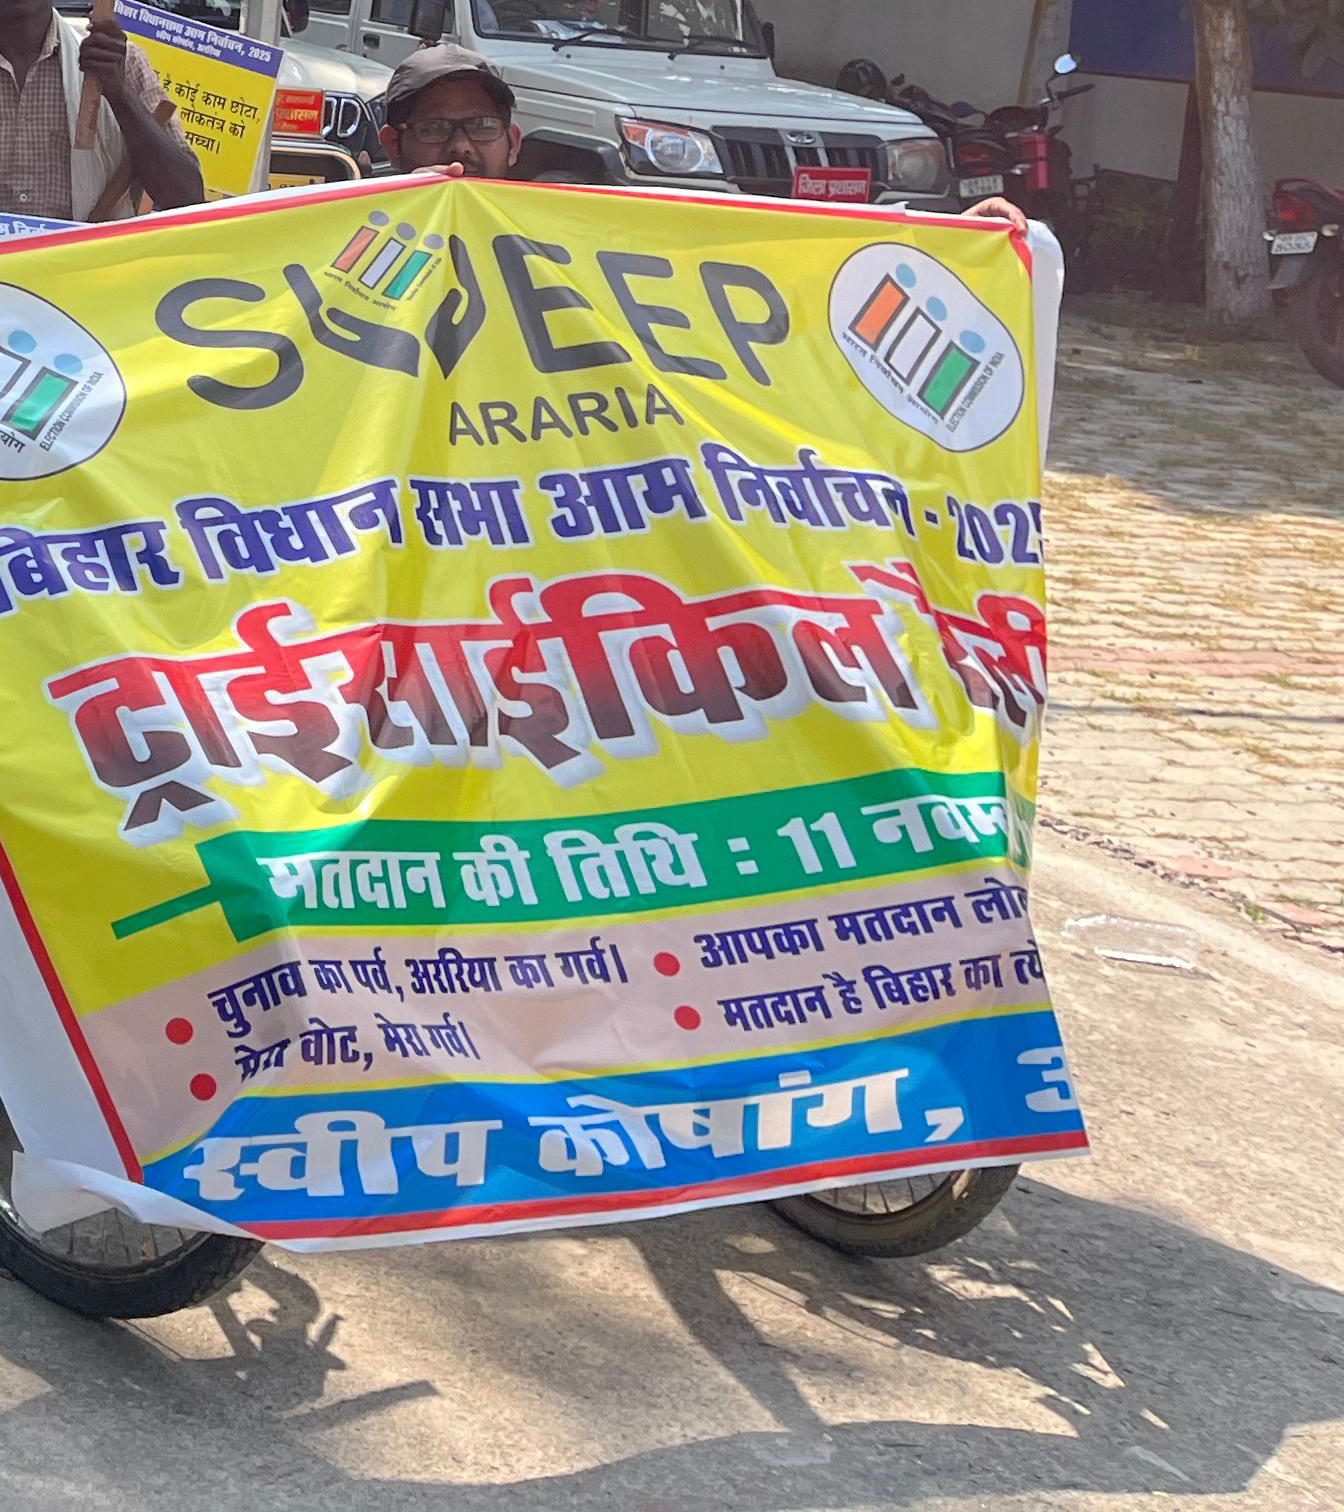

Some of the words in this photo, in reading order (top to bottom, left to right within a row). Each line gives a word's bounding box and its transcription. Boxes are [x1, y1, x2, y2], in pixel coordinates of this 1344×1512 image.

[228, 119, 247, 139] को
[449, 382, 685, 447] ARARIA
[177, 479, 403, 580] विधान
[411, 478, 529, 547] सभा
[539, 457, 708, 535] आम
[701, 442, 915, 537] निर्वाचन
[256, 852, 441, 909] मतदान
[452, 833, 539, 907] की
[543, 821, 708, 904] तिथि
[776, 810, 857, 874] 11
[693, 918, 825, 970] आपका
[828, 895, 963, 948] मतदान
[207, 960, 307, 1039] चुनाव
[308, 959, 354, 994] का
[348, 945, 405, 1003] पर्व,
[404, 947, 503, 996] अररिया
[505, 952, 554, 989] का
[555, 936, 628, 985] गर्व।
[718, 985, 832, 1032] मतदान
[823, 970, 863, 1015] है
[862, 962, 956, 1011] बिहार
[959, 954, 1004, 991] का
[299, 1017, 374, 1072] वोट,
[183, 1110, 503, 1202] स्वीप
[528, 1068, 966, 1178] कोषांग,
